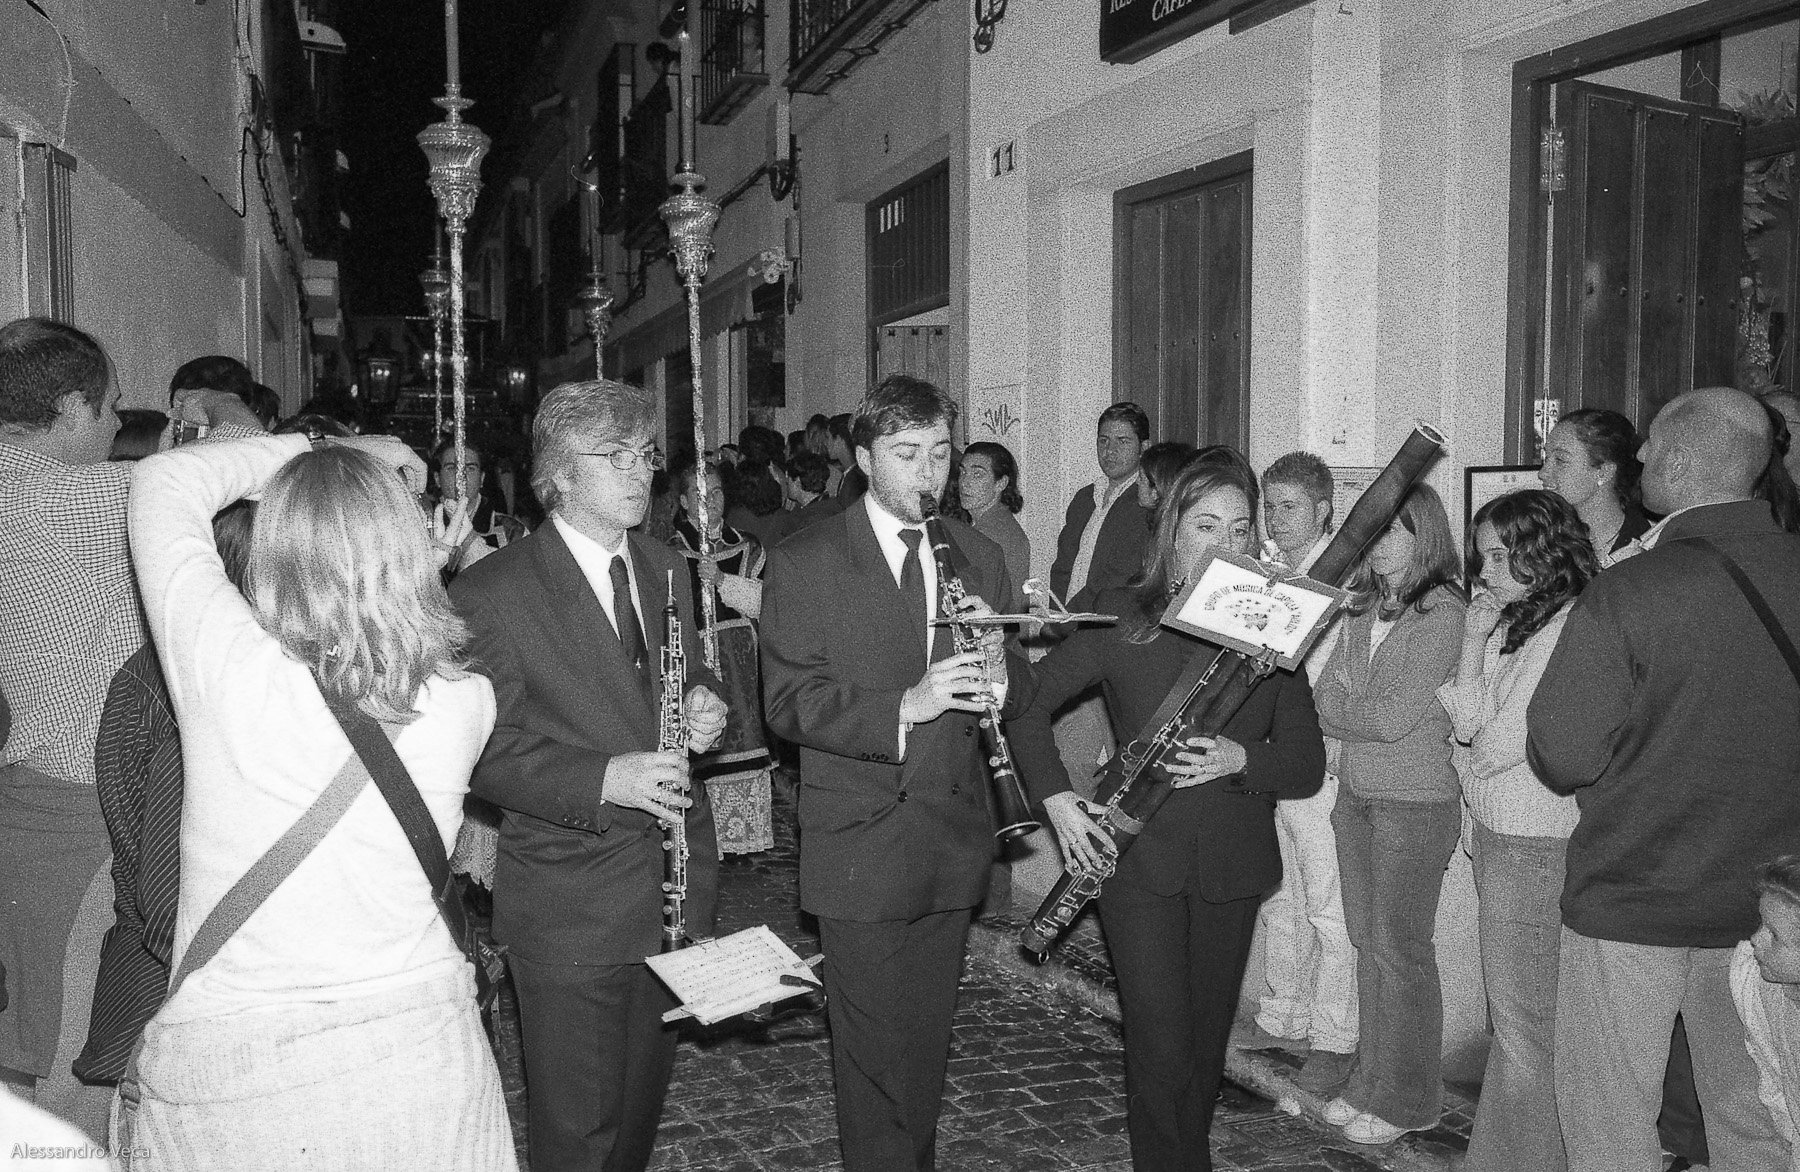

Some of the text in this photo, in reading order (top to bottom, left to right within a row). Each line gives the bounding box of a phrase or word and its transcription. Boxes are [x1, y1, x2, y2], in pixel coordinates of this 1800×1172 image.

[993, 140, 1014, 177] 11
[1221, 585, 1232, 595] DE
[1263, 588, 1275, 598] DE
